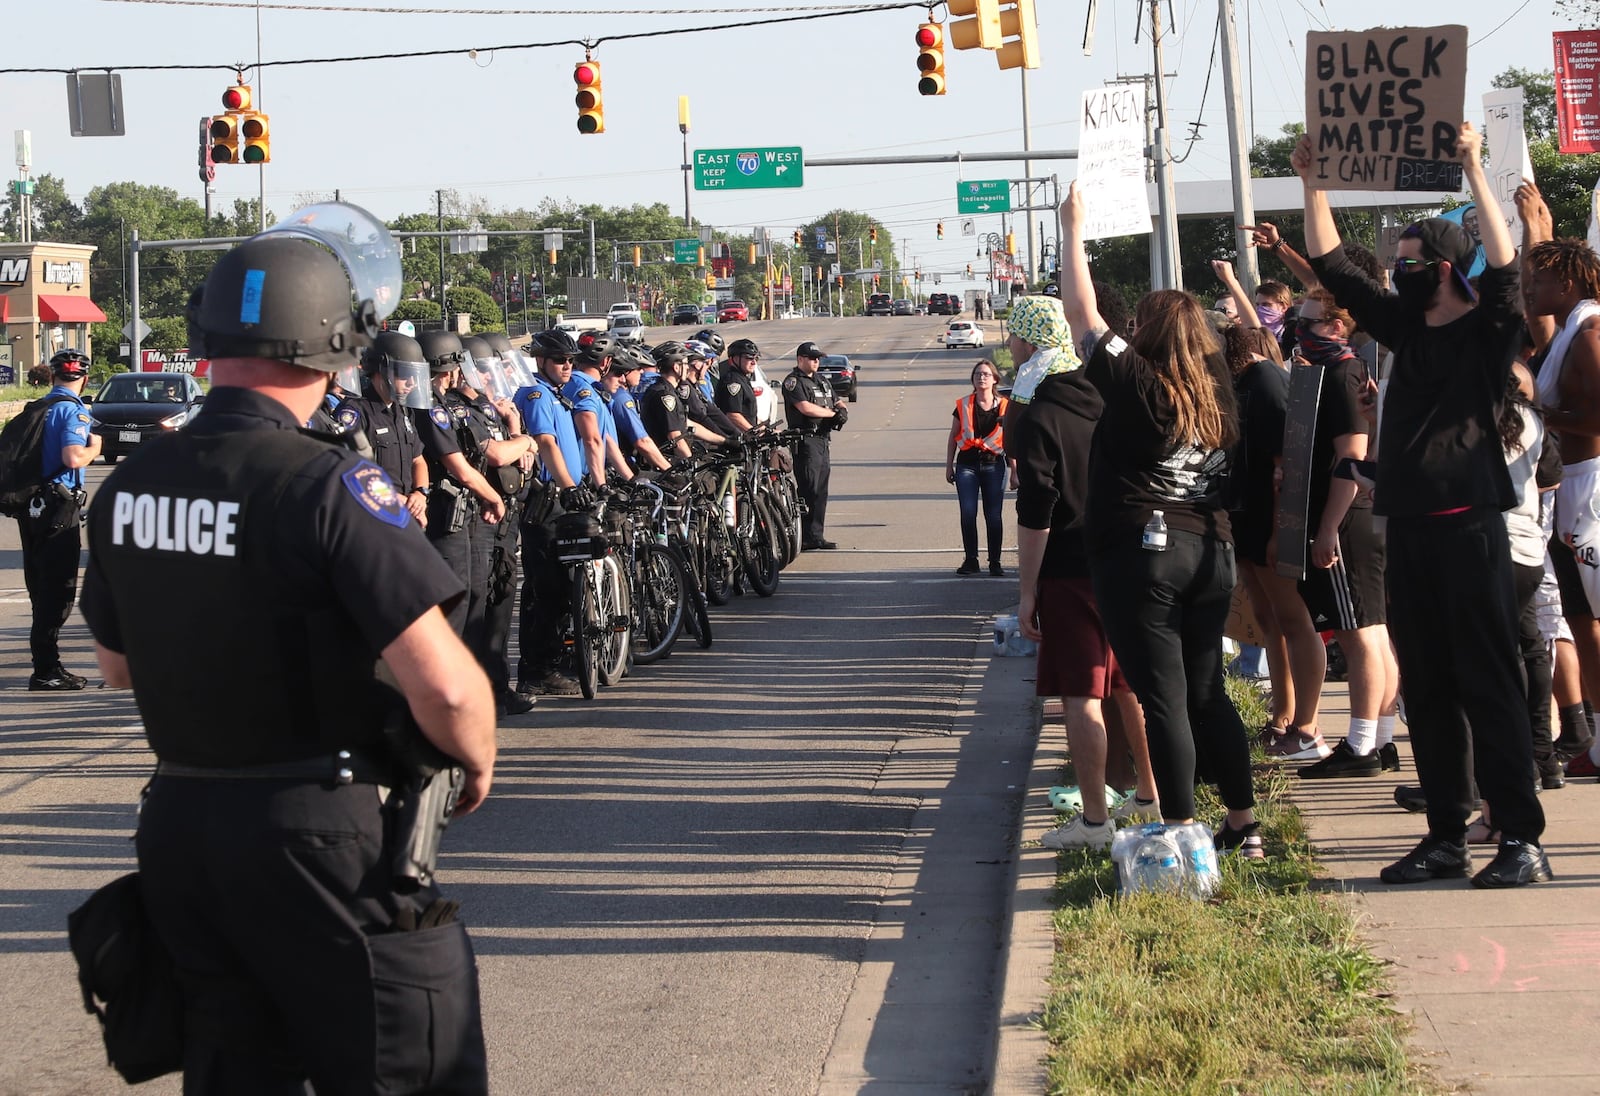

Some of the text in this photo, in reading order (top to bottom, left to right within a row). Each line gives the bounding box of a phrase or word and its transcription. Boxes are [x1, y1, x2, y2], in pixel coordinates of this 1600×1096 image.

[1317, 36, 1448, 81] BLACK
[1084, 89, 1140, 131] KAREN
[1318, 79, 1425, 124] LIVES
[1487, 106, 1509, 123] THE
[1319, 119, 1457, 159] MATTER
[698, 153, 730, 165] EAST
[739, 158, 757, 171] 70
[765, 151, 799, 162] WEST
[703, 168, 726, 176] KEEP
[1317, 156, 1329, 179] I
[1338, 155, 1393, 182] CAN'T
[704, 179, 725, 187] LEFT
[962, 194, 1005, 202] Indianapolis
[112, 491, 240, 557] POLICE
